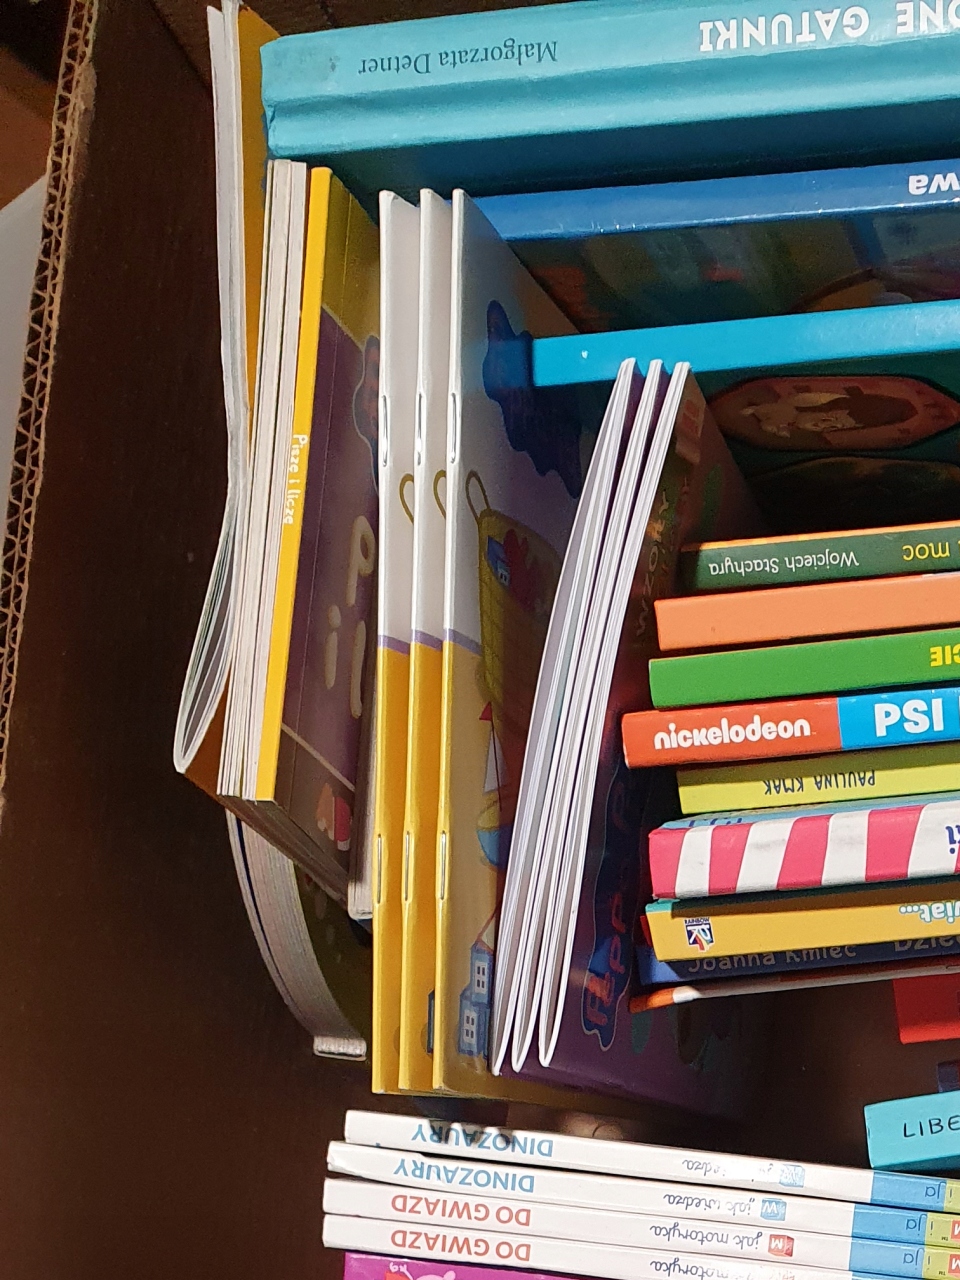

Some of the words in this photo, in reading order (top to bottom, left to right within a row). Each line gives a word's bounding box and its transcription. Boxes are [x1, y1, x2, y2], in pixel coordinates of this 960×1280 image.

[698, 6, 870, 52] GATUNKI
[358, 53, 430, 77] Detner
[437, 37, 558, 70] Małgorzata
[288, 433, 308, 473] Piszę
[283, 489, 301, 524] liczę
[783, 549, 858, 572] Wojciech
[902, 543, 950, 563] moc
[706, 554, 779, 577] Stachyra
[653, 712, 811, 750] nickelodeon
[873, 698, 944, 737] PSI
[762, 777, 804, 796] KMAK
[814, 768, 876, 792] PAULINA
[411, 1122, 555, 1158] DINOZAURY
[393, 1158, 536, 1192] DINOZAURY
[923, 1185, 944, 1203] ja
[390, 1193, 489, 1224] GWIAZD
[496, 1206, 532, 1228] DO
[763, 1201, 779, 1215] W
[649, 1223, 729, 1246] motoryka
[904, 1217, 926, 1236] ja
[390, 1229, 489, 1260] GWIAZD
[496, 1239, 533, 1262] DO
[732, 1231, 762, 1250] jak
[769, 1237, 783, 1250] M
[904, 1250, 924, 1271] ja
